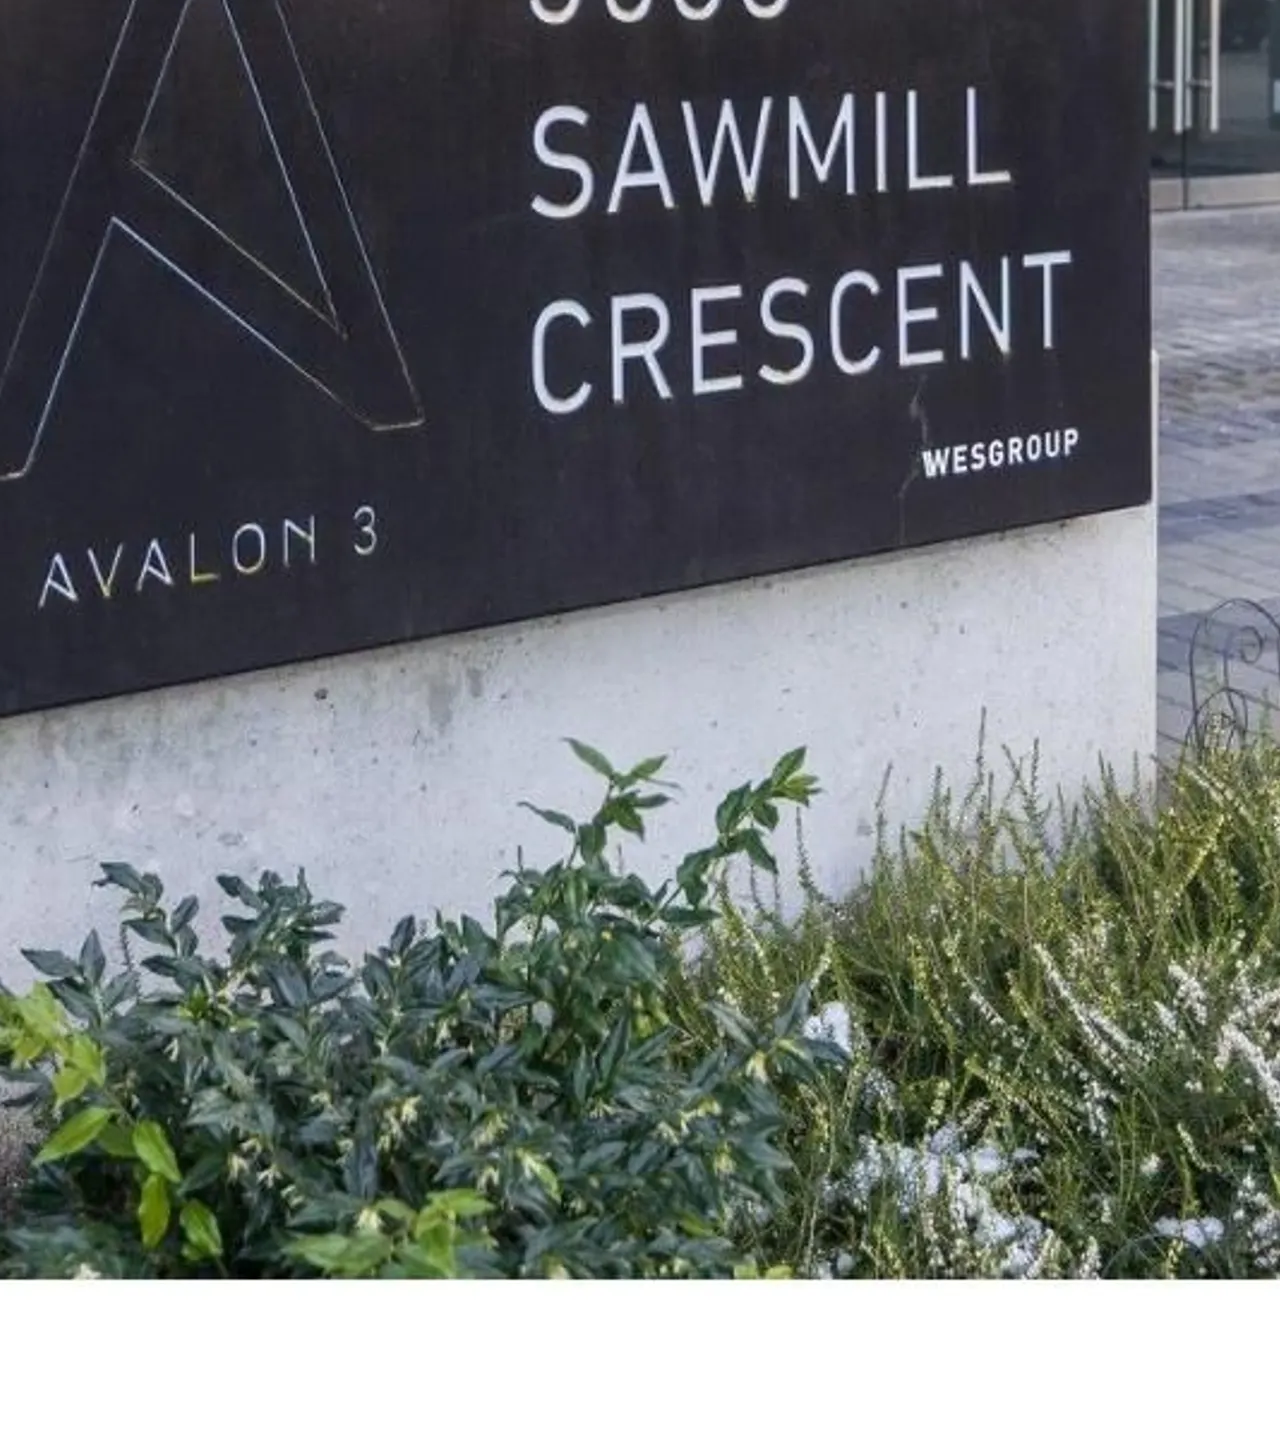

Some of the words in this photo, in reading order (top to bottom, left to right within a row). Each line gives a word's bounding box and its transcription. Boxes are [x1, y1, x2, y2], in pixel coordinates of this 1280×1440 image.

[530, 86, 1012, 219] SAWMILL
[531, 250, 1072, 414] CRESCENT
[921, 427, 1080, 478] WESGROUP
[38, 514, 317, 608] AVALON
[353, 505, 378, 556] 3
